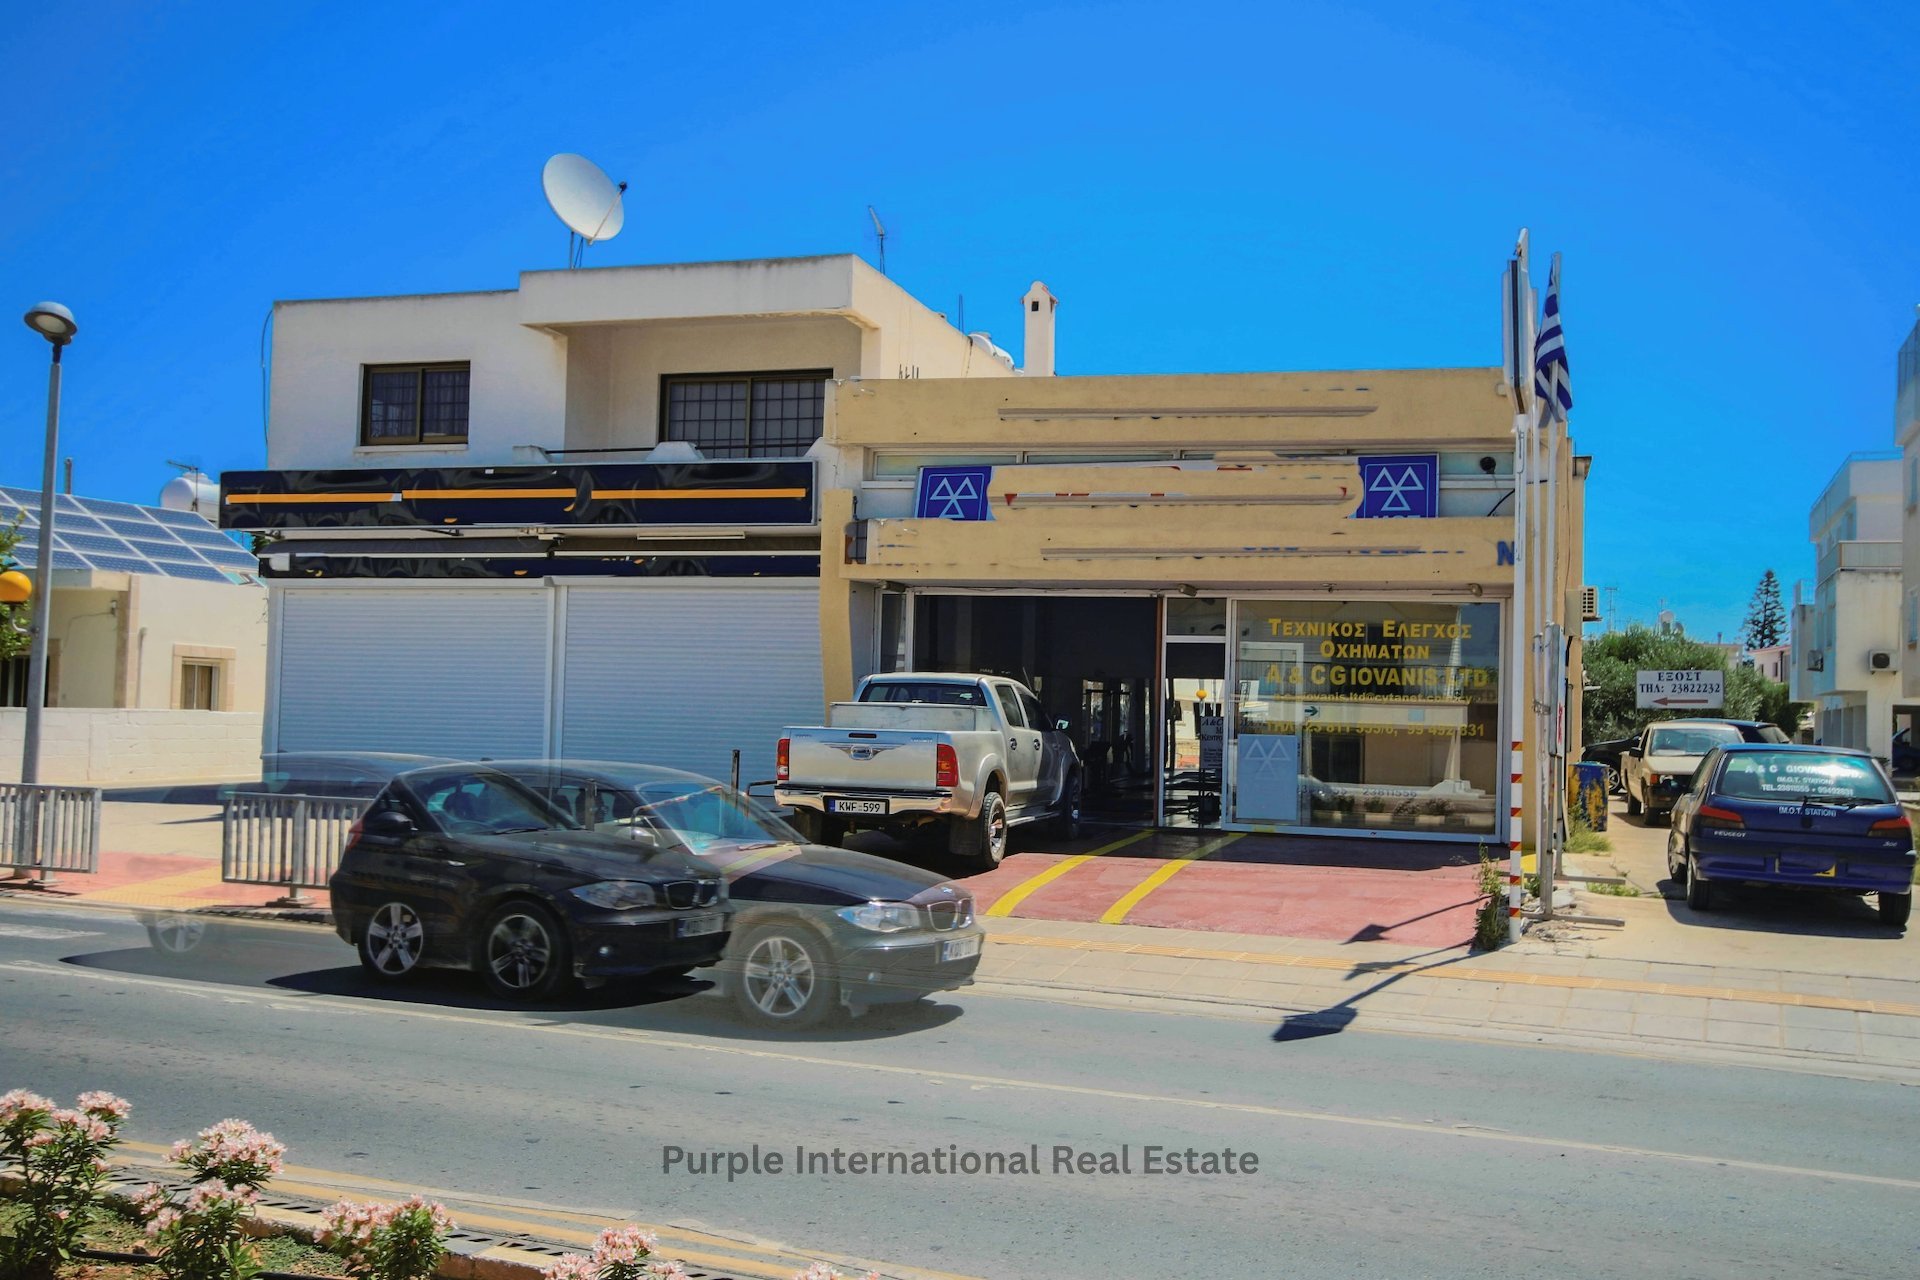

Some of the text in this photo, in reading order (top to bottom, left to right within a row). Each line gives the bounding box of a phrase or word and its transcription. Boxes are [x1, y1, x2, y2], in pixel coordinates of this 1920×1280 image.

[1320, 640, 1430, 660] ΟΧΗΜΑΤΩΝ
[1267, 663, 1281, 685] A
[1657, 671, 1702, 682] ΕΞΟΣΤ
[1639, 683, 1721, 695] ΤΗΛ: 23822232
[839, 801, 880, 813] KWF 599
